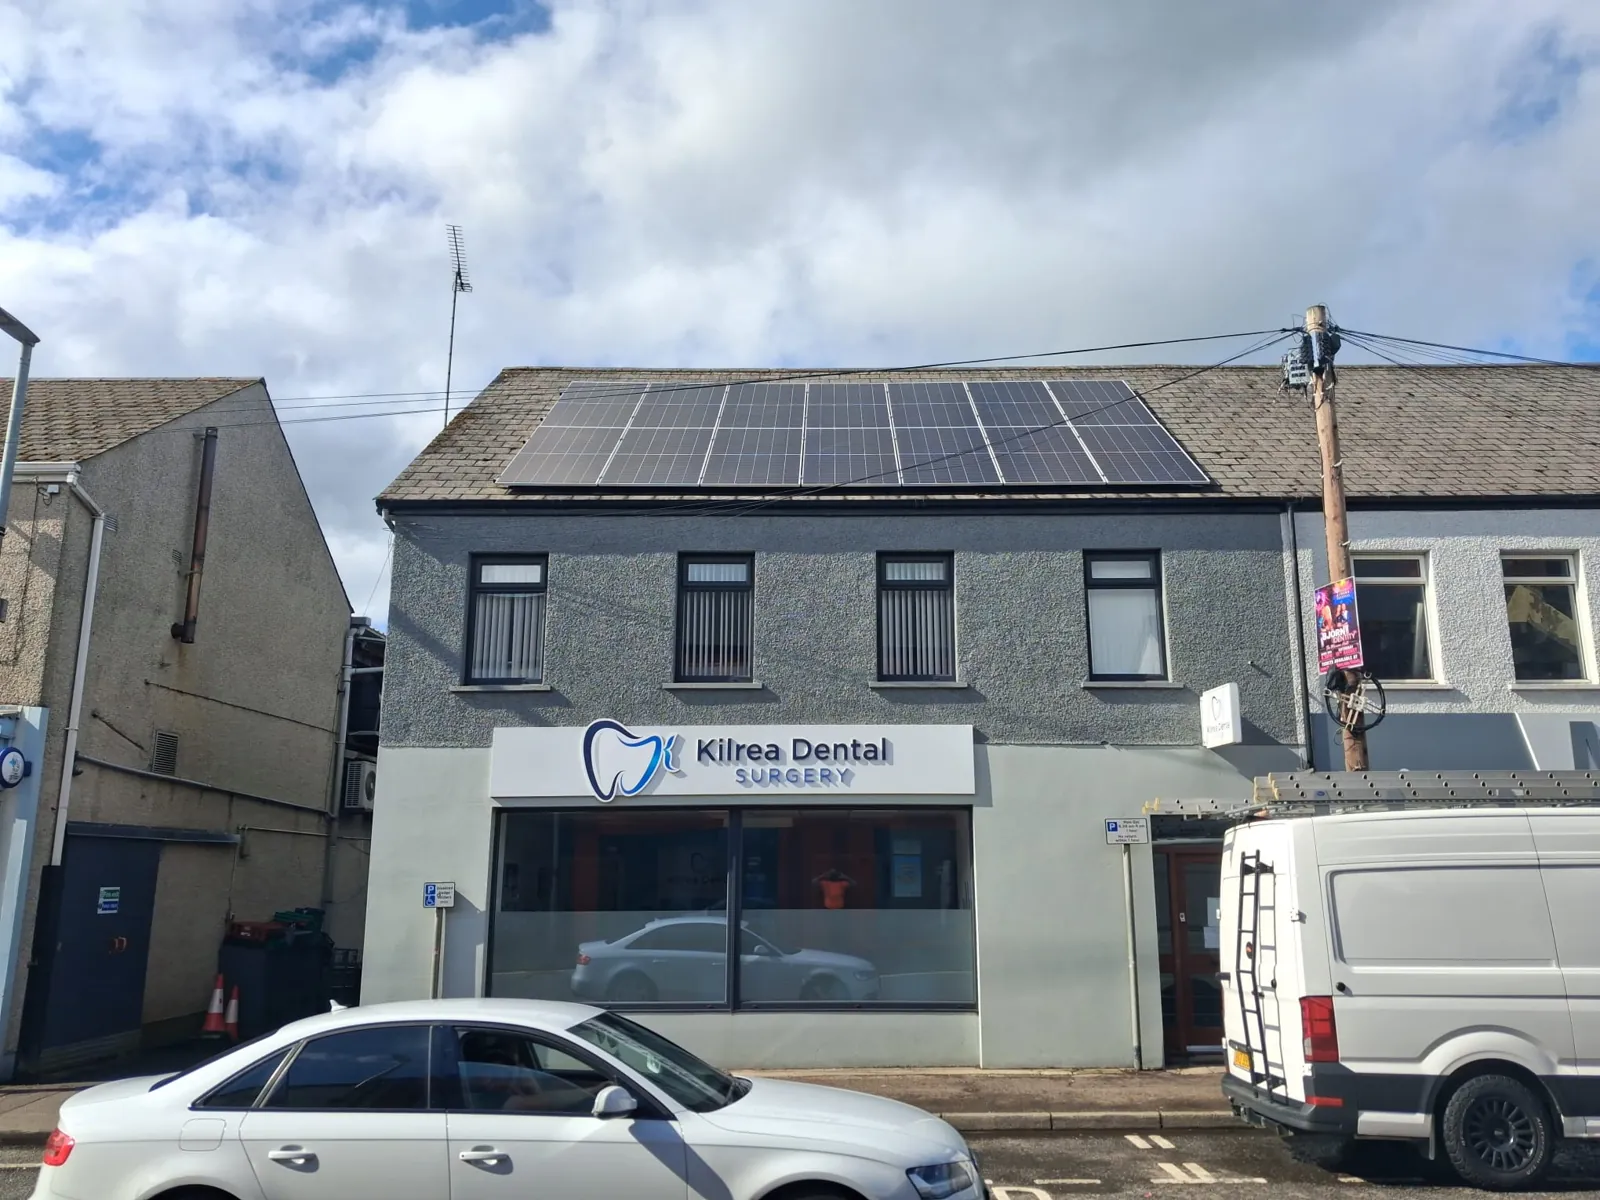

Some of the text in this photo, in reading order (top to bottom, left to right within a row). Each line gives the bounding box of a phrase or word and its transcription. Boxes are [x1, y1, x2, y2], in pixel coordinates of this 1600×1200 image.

[697, 737, 887, 762] Kilrea Dental
[735, 767, 850, 783] SURGERY
